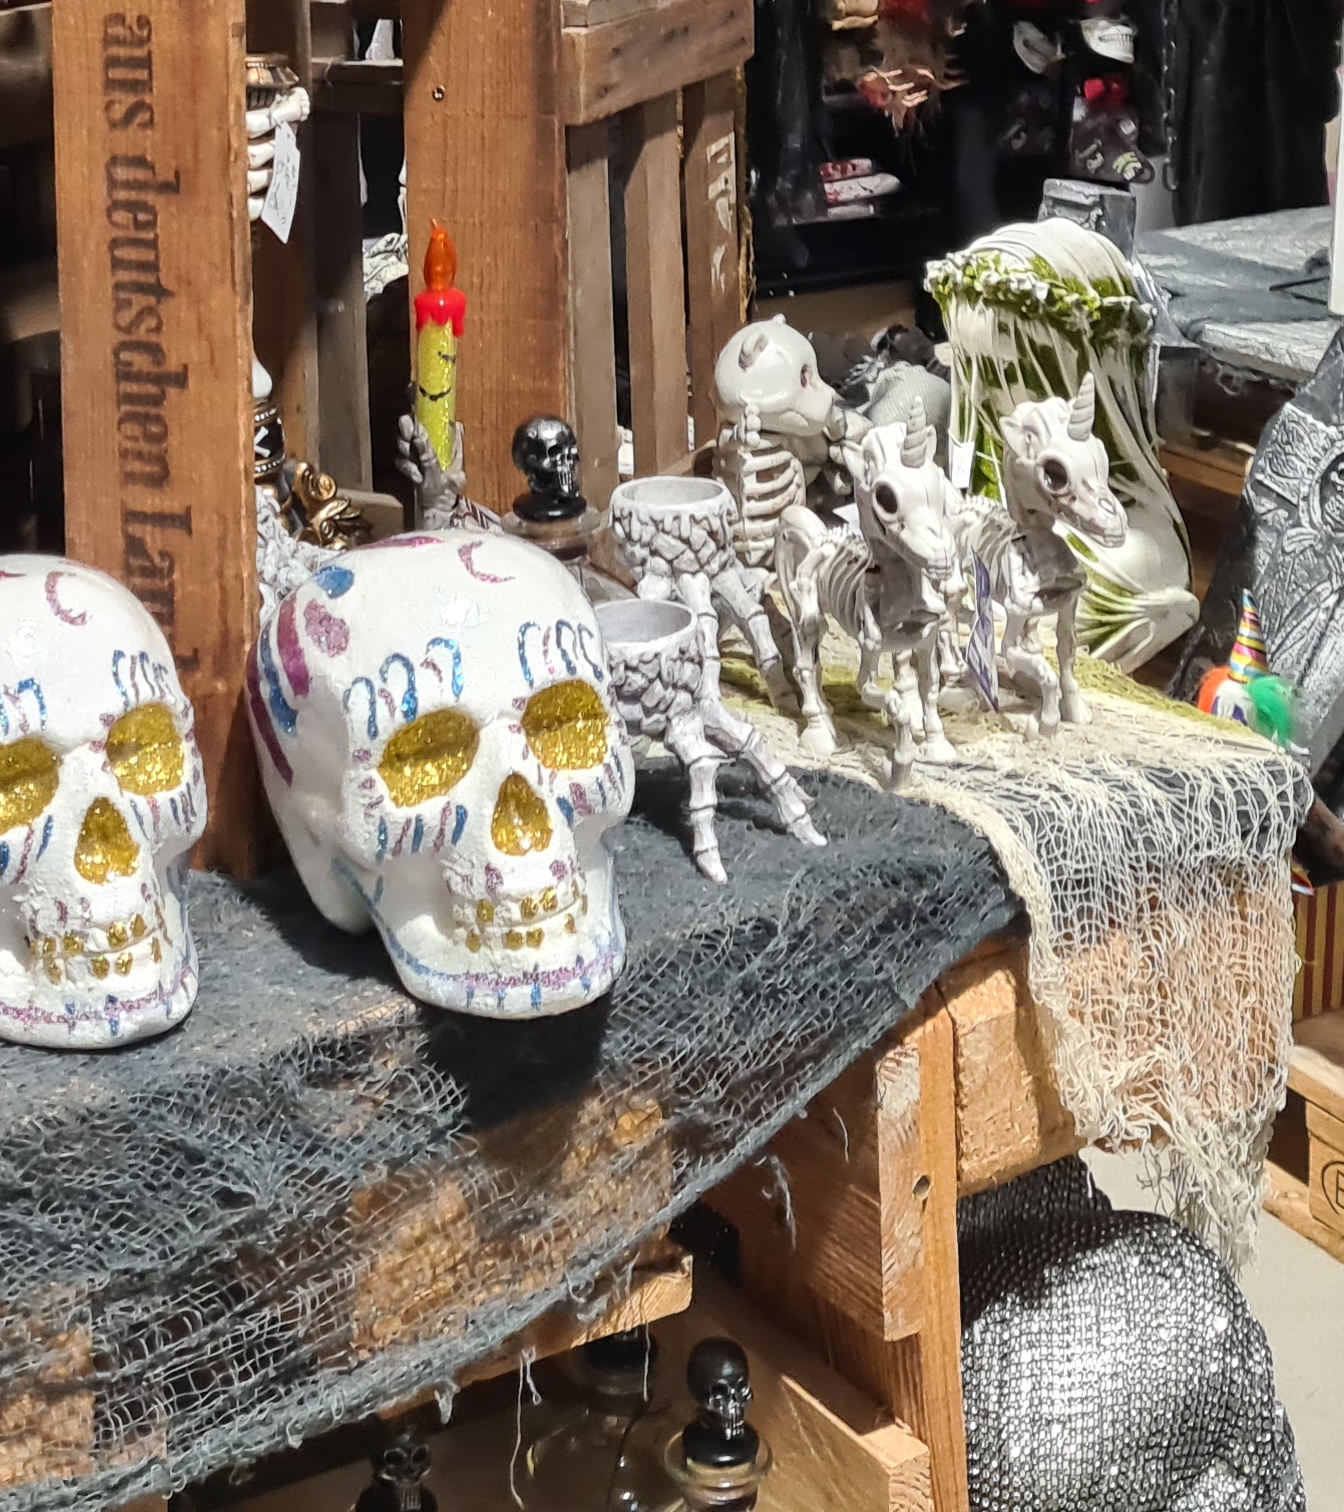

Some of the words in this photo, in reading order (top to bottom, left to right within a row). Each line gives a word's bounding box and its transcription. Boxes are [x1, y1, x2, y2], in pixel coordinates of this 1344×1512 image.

[103, 13, 155, 129] aus
[105, 154, 191, 488] deutschen
[120, 501, 200, 673] Lan
